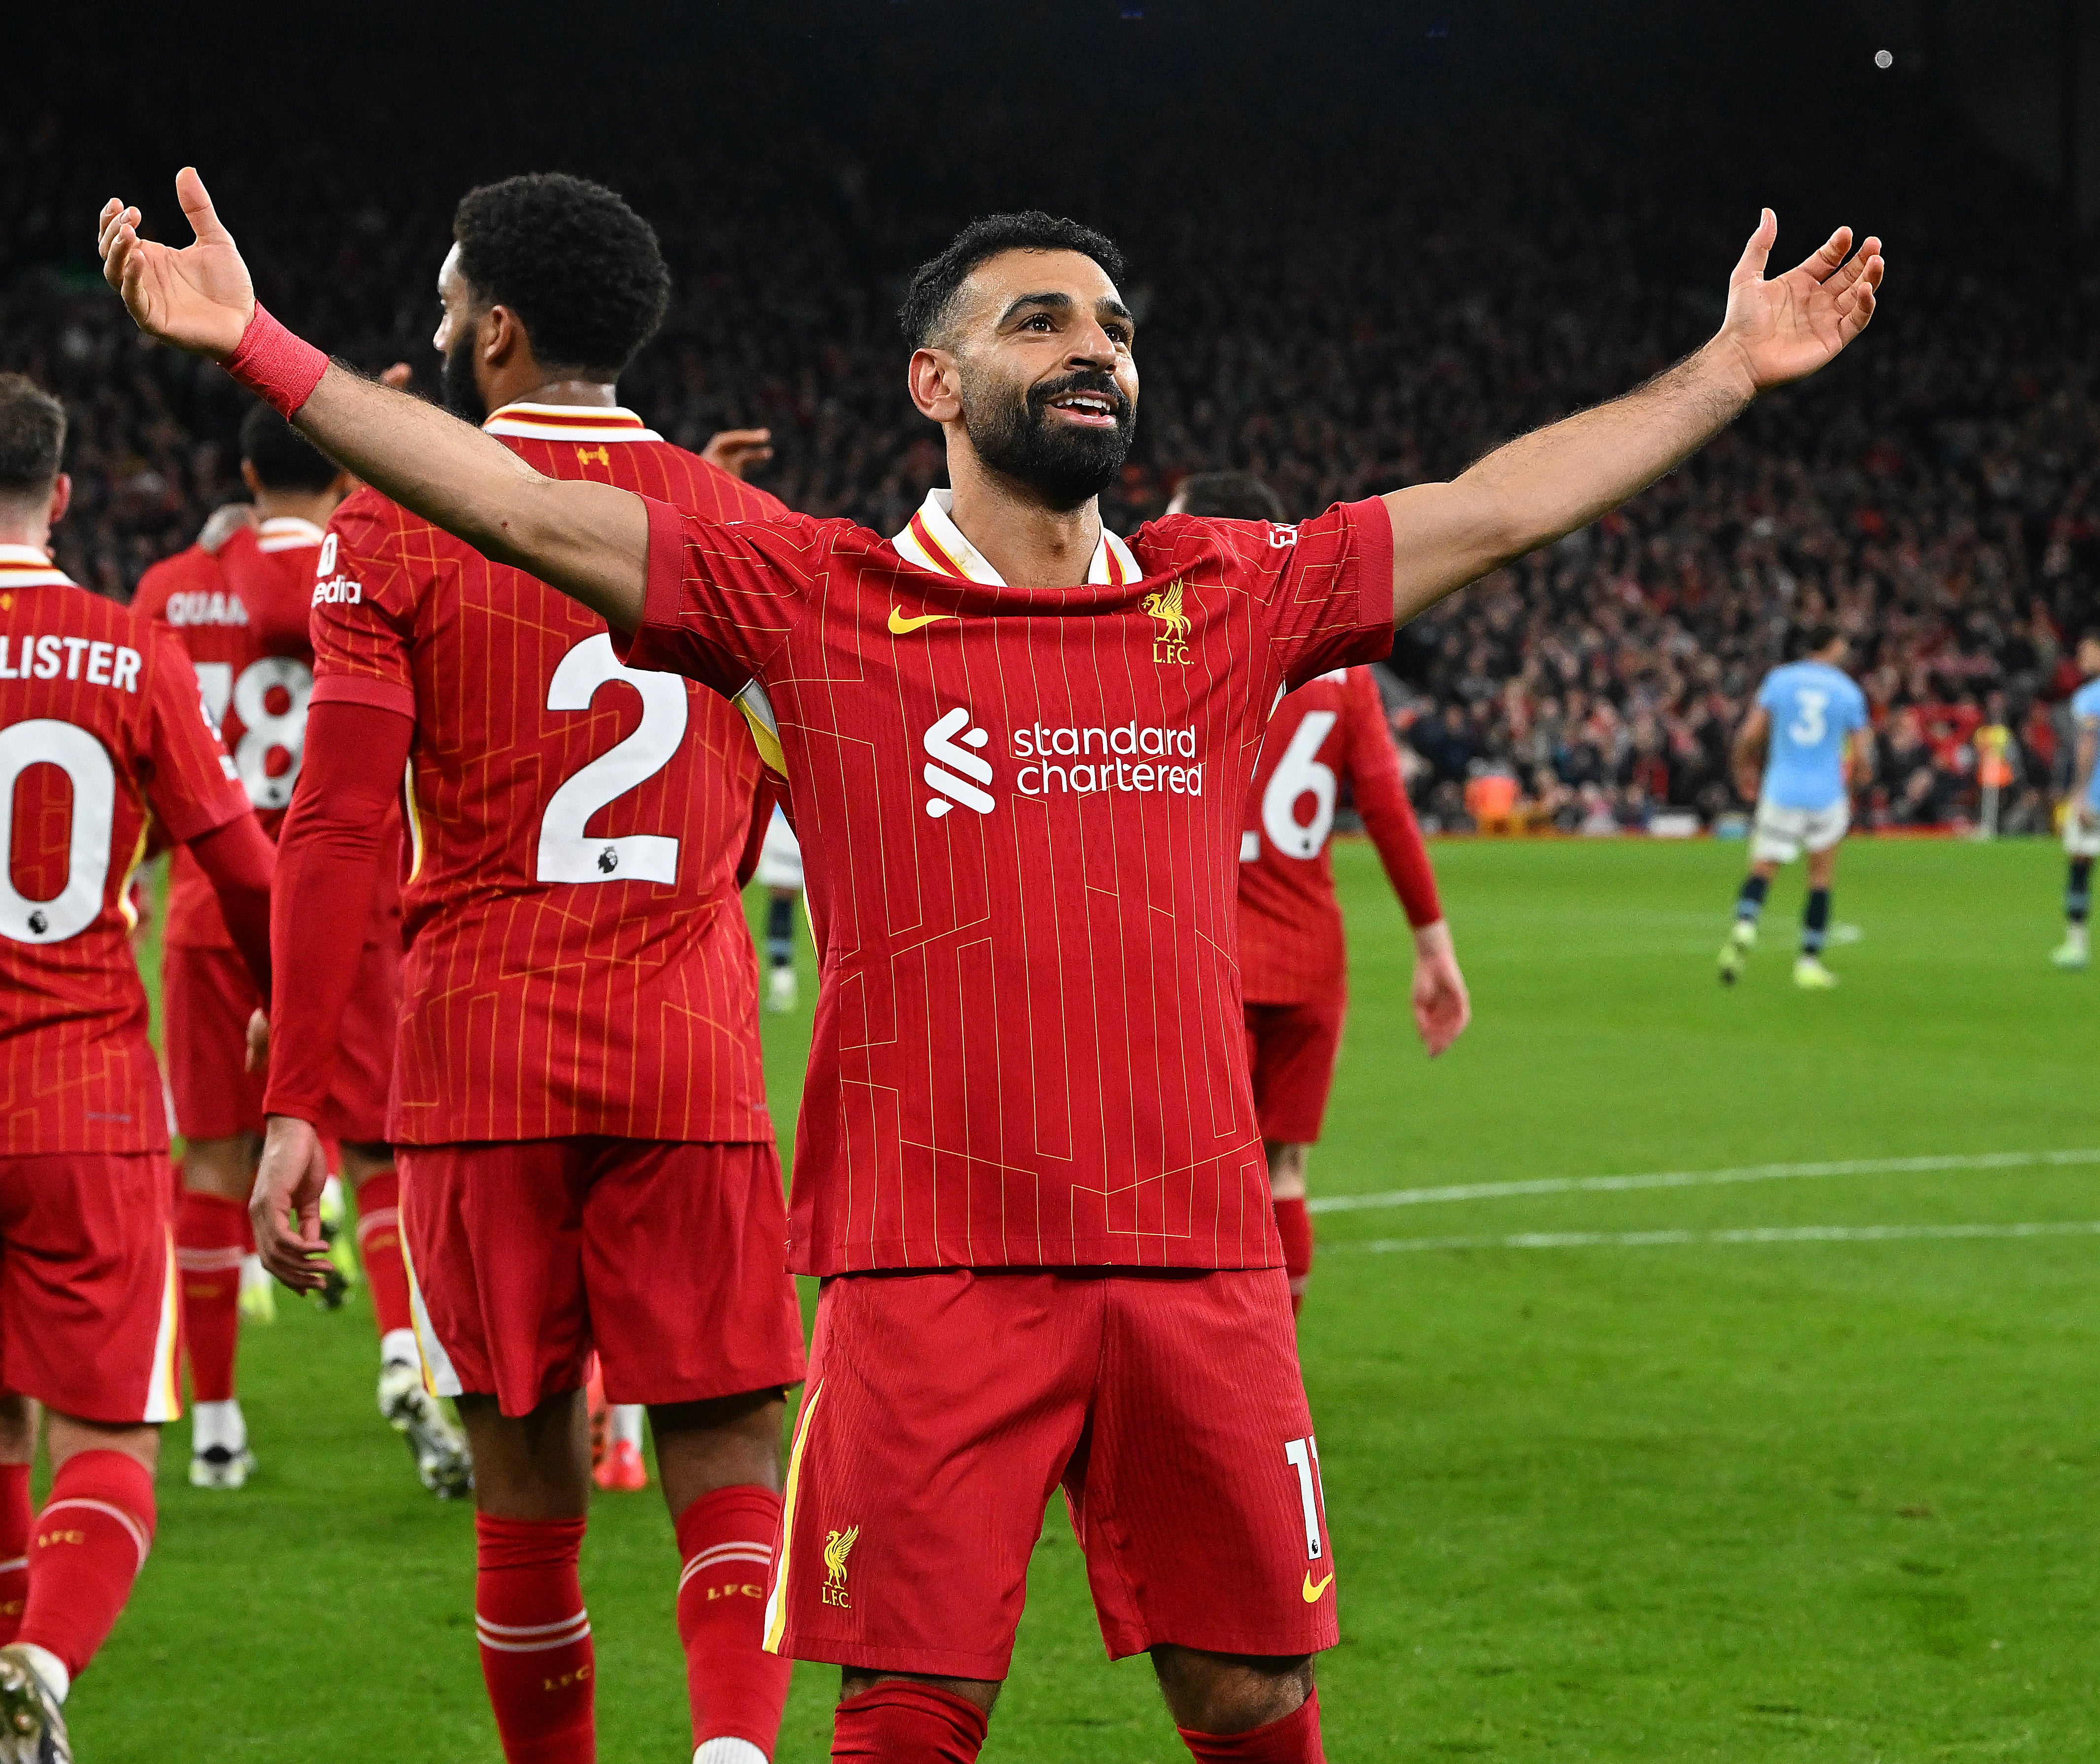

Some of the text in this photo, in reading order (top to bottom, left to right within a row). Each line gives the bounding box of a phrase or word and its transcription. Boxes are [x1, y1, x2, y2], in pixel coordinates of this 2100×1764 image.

[311, 574, 362, 608] edia
[1153, 643, 1195, 665] L.F.C.
[1788, 691, 1829, 746] 3
[536, 633, 689, 885] 2
[1014, 720, 1196, 759] standard
[1017, 757, 1203, 797] chartered
[1239, 710, 1337, 862] 6
[1284, 1435, 1326, 1560] 1
[822, 1587, 851, 1609] L.F.C.
